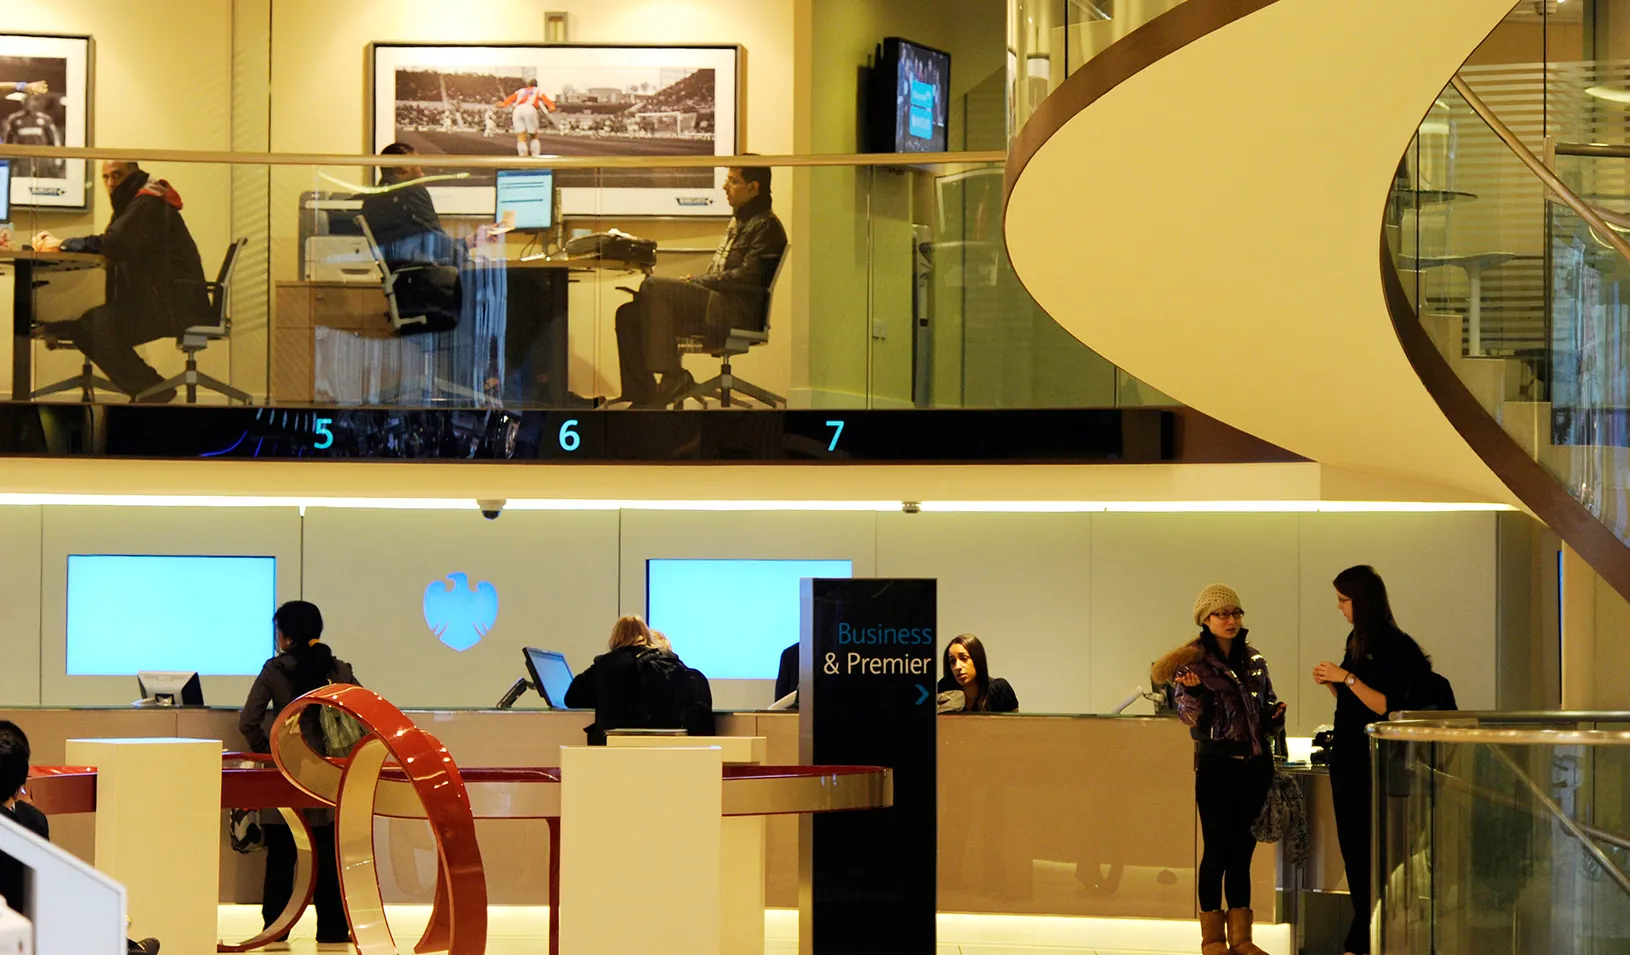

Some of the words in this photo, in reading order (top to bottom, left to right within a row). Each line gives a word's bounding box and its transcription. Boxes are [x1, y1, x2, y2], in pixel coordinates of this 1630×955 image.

[313, 418, 334, 449] 5
[559, 419, 581, 451] 6
[825, 420, 845, 452] 7
[838, 622, 933, 645] Business
[823, 652, 840, 675] &
[847, 652, 932, 675] Premier
